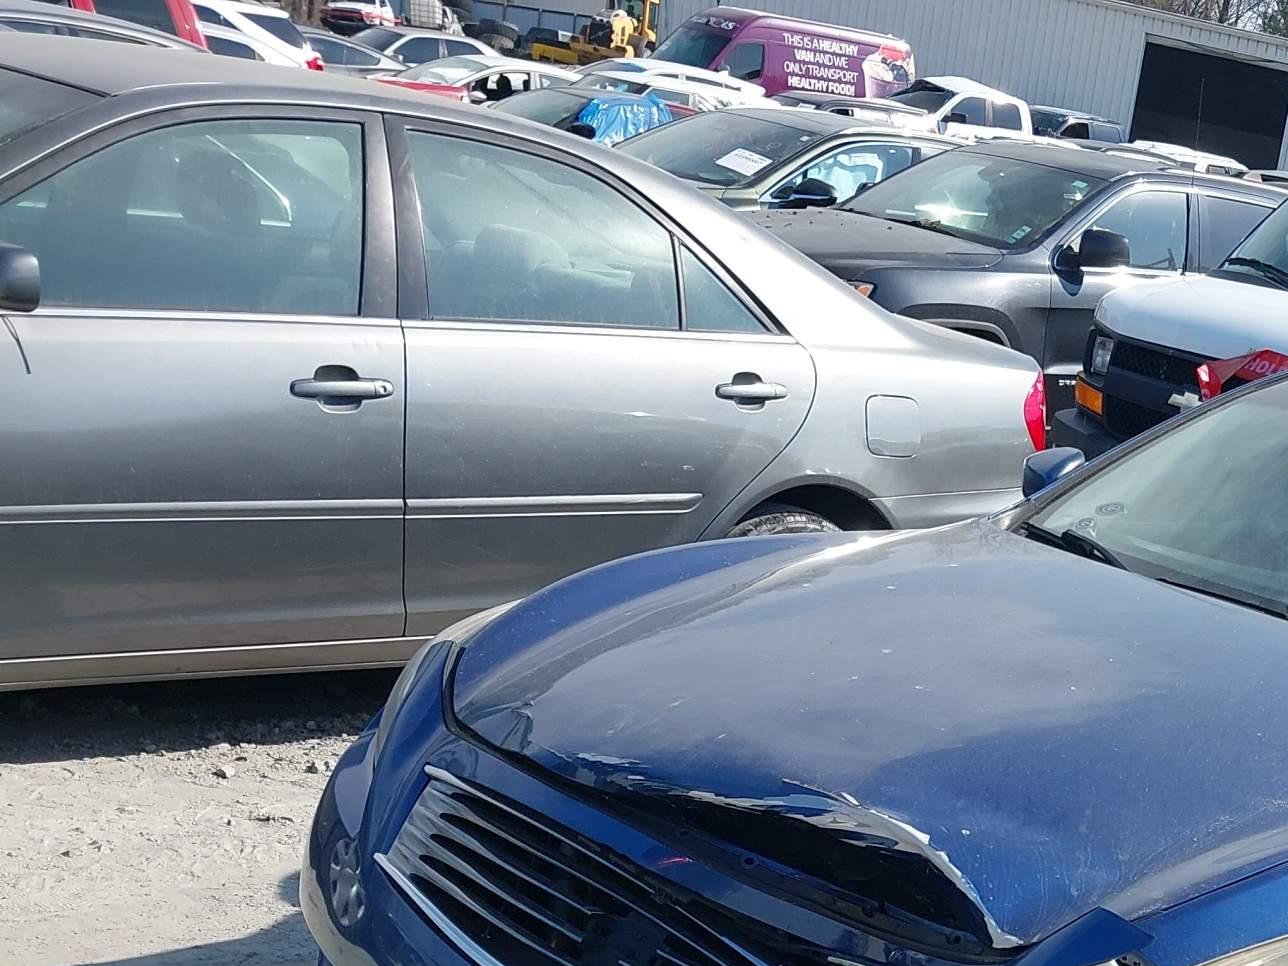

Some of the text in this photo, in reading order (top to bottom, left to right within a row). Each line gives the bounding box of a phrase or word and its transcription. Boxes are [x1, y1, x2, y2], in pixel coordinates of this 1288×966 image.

[782, 32, 859, 56] THIS IS A HEALTHY
[794, 48, 849, 69] VAN AND WE
[784, 61, 859, 83] ONLY TRANSPORT
[787, 75, 856, 97] HEALTHY FOOD!
